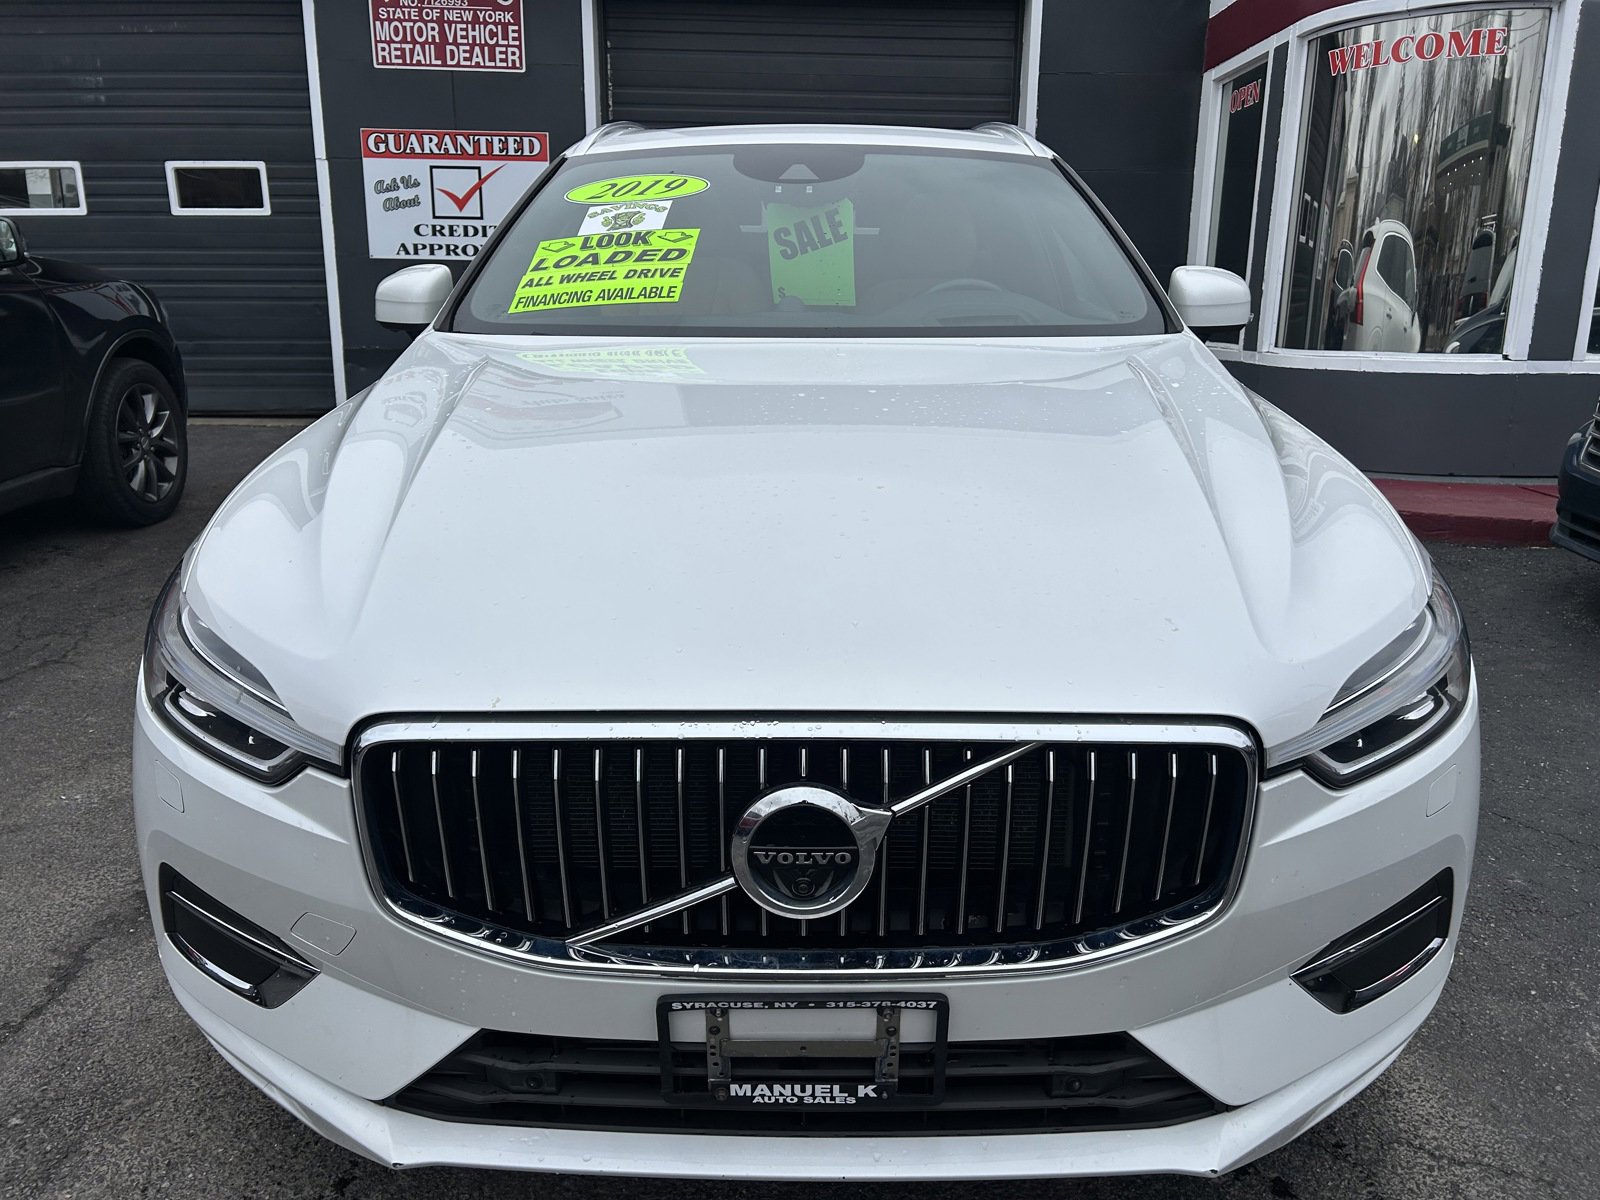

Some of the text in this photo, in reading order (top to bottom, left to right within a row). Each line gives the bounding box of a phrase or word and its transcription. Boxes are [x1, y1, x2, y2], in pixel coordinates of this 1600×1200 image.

[379, 8, 514, 23] STATE OF NEW YORK
[375, 21, 519, 45] MOTOR VEHICLE
[377, 43, 520, 67] RETAIL DEALER
[1328, 27, 1508, 76] WELCOME
[1230, 78, 1262, 113] OPEN
[367, 132, 542, 156] GUARANTEED
[374, 174, 421, 194] Ask Us
[585, 178, 689, 200] 2019
[383, 194, 421, 212] About
[587, 202, 668, 219] SAVINGS
[580, 231, 656, 250] LOOK
[773, 208, 848, 261] SALE
[396, 242, 483, 257] APPRO
[530, 248, 690, 272] LOADED
[521, 267, 683, 289] ALL WHEEL DRIVE
[514, 286, 678, 309] FINANCING AVAILABLE
[753, 852, 851, 865] VOLVO
[671, 1001, 768, 1009] SYRACUSE,
[730, 1084, 878, 1097] MANUEL K
[752, 1096, 857, 1104] AUTO SALES
